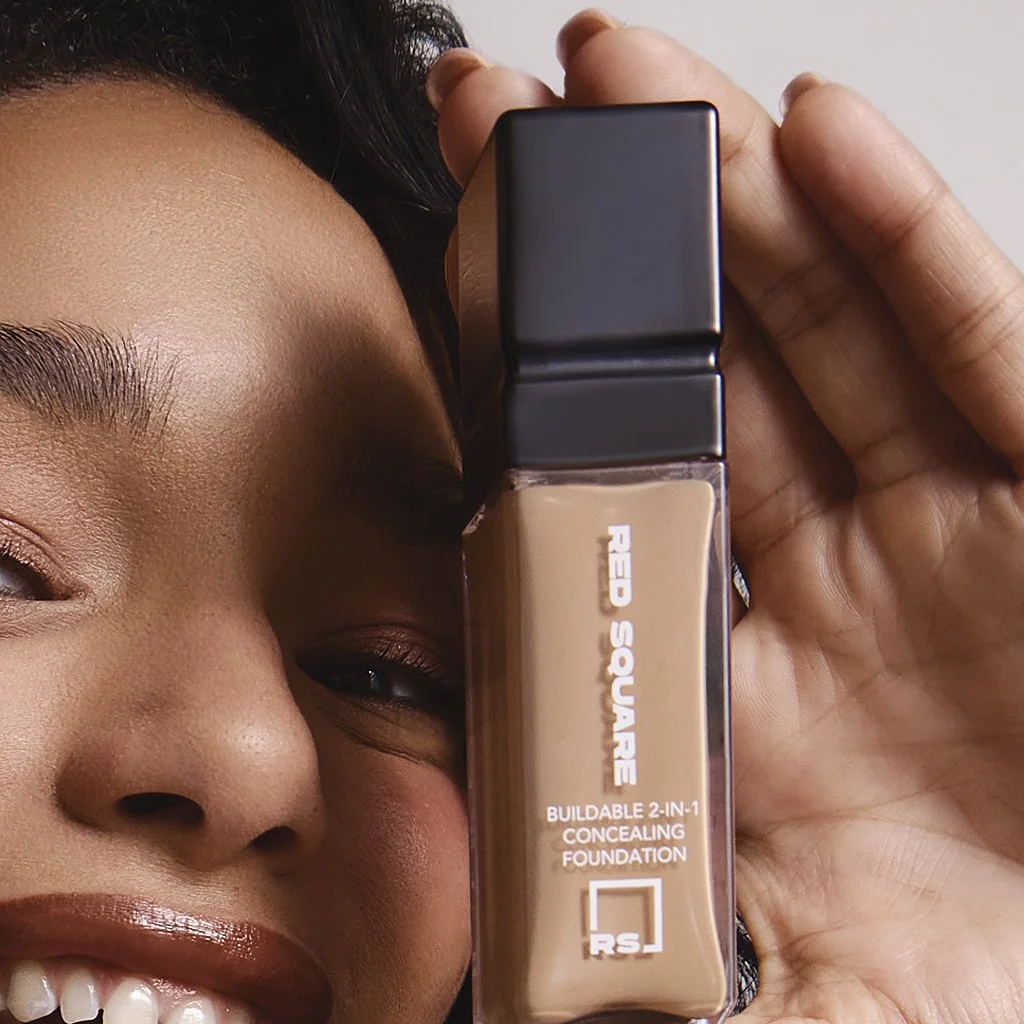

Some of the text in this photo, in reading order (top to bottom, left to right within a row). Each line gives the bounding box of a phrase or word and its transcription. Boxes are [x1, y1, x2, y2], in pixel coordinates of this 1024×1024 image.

[607, 524, 637, 786] RED SQUARE
[546, 800, 699, 822] BUILDABLE 2-IN-1
[562, 823, 685, 844] CONCEALING
[562, 846, 687, 867] FOUNDATION
[590, 932, 641, 955] RS
